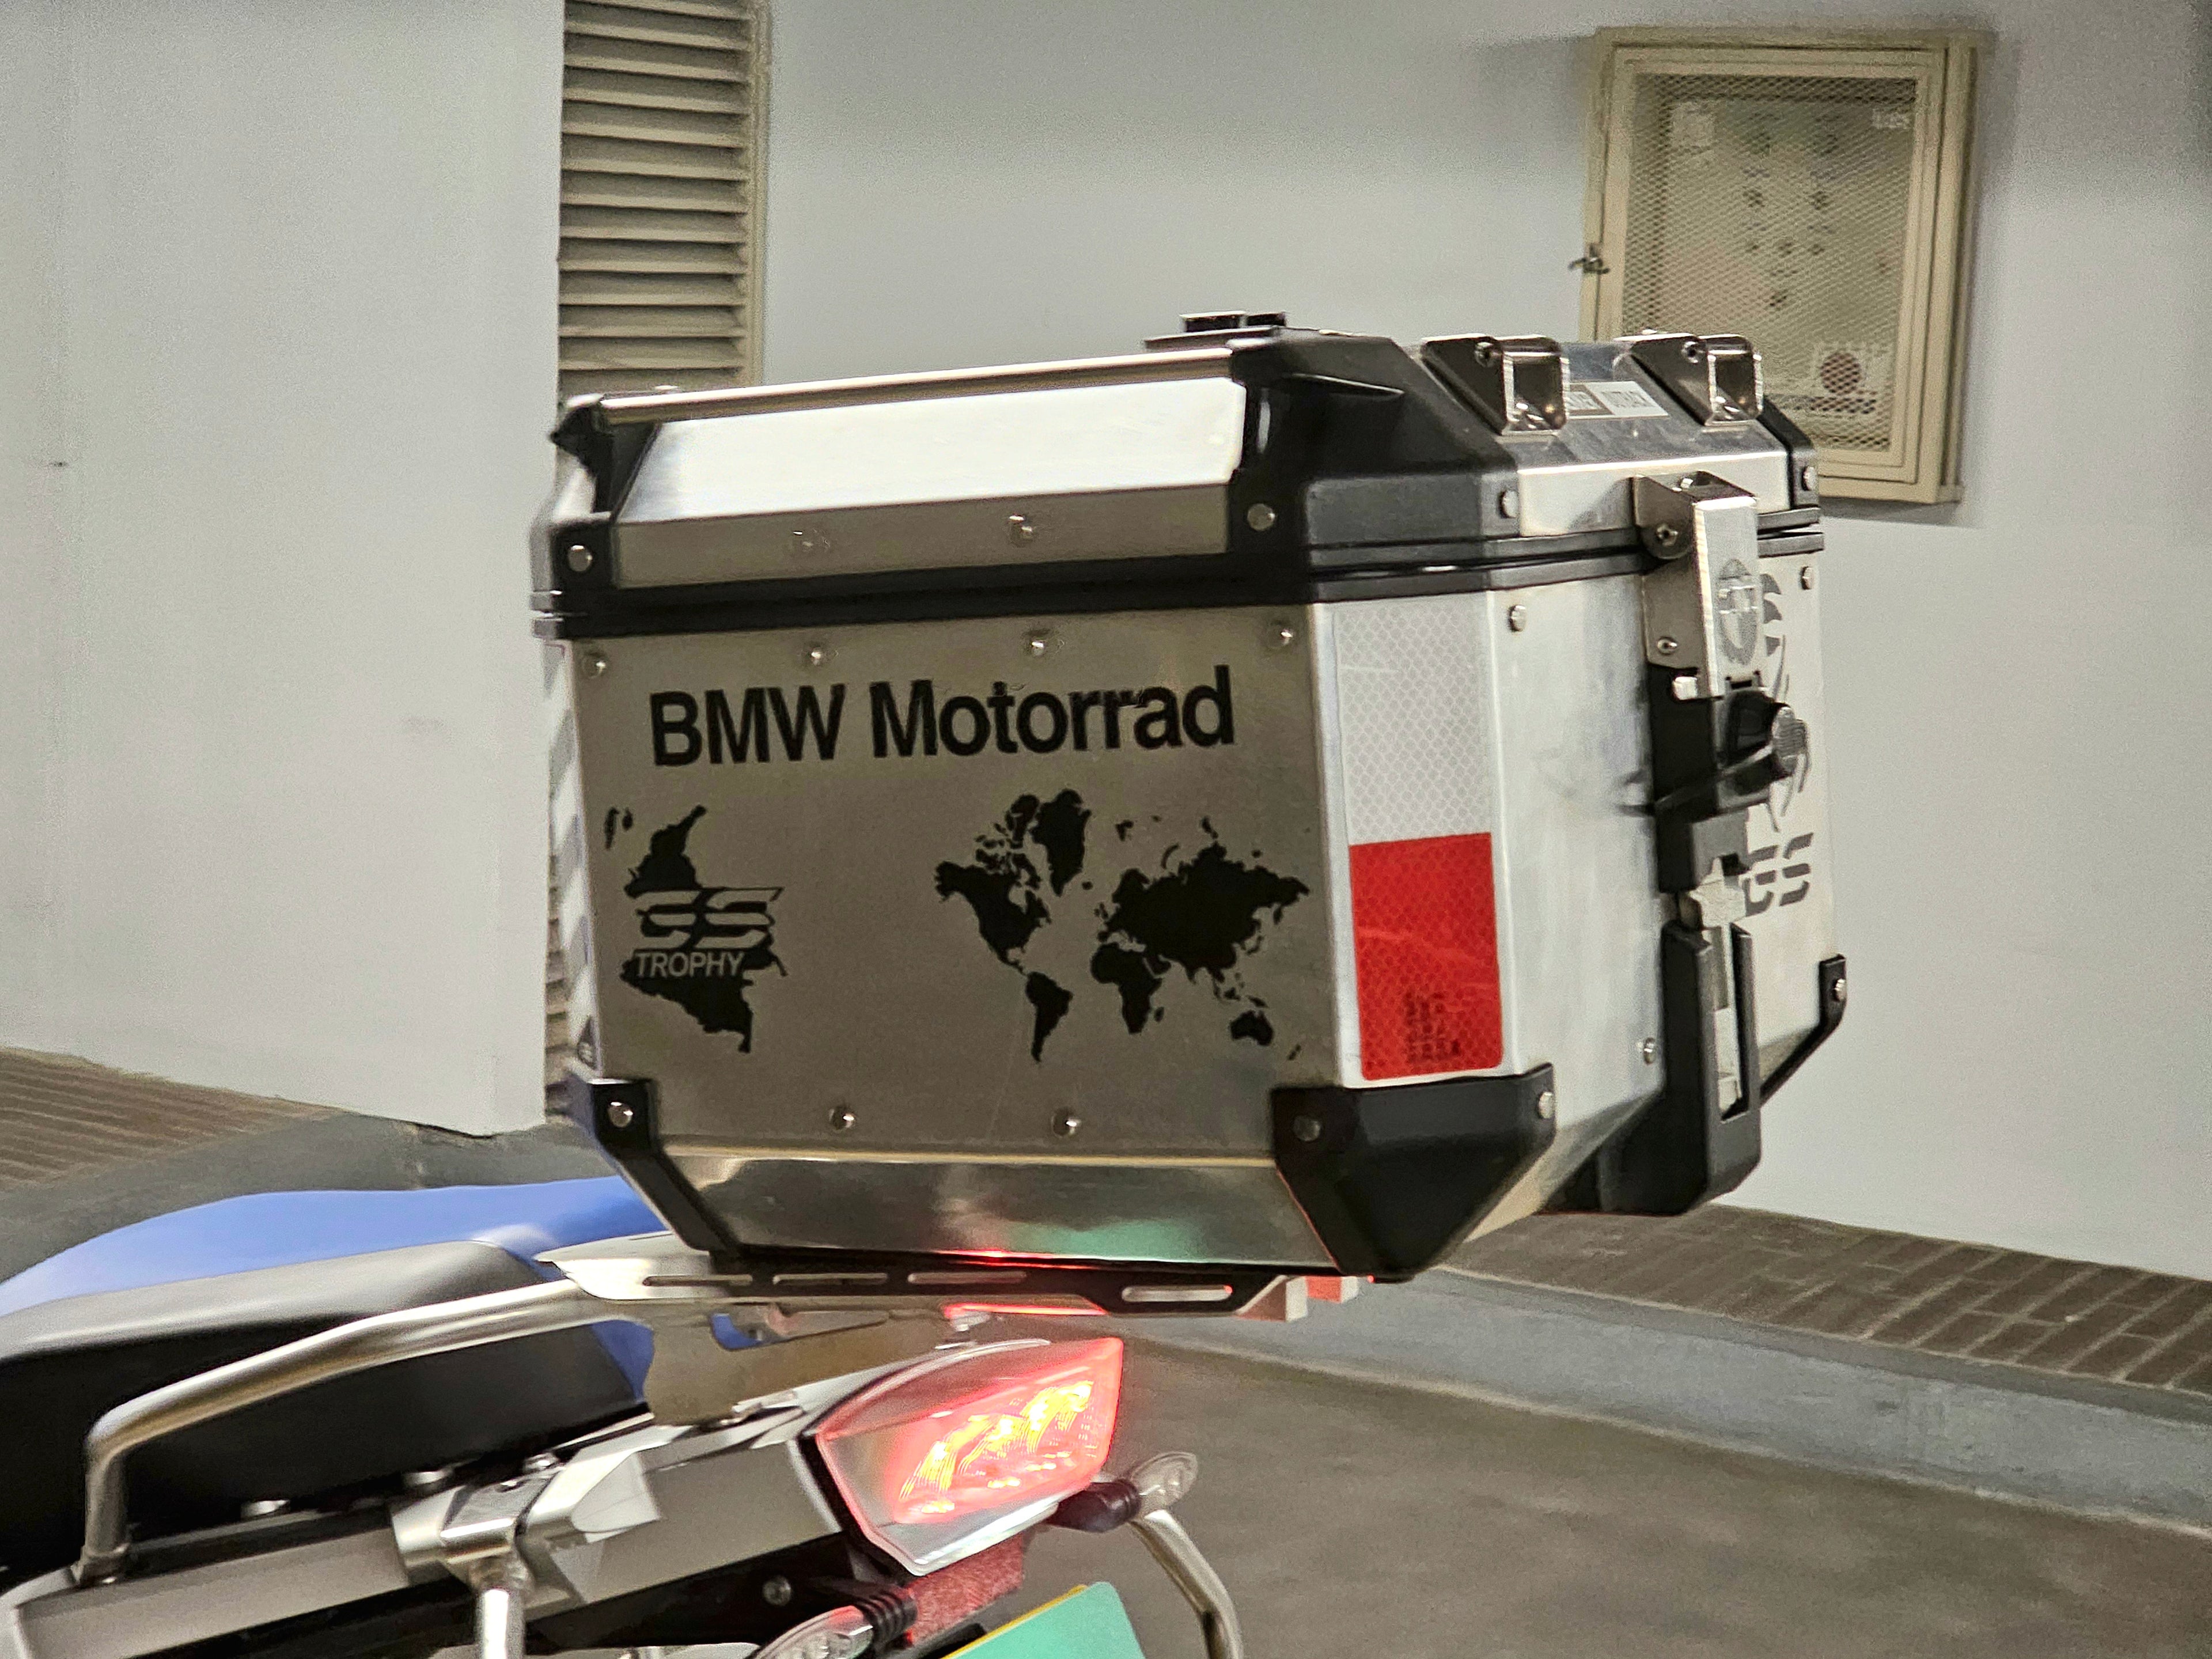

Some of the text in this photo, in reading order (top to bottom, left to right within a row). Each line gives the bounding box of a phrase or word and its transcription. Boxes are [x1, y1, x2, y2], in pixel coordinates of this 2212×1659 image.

[649, 664, 1236, 767] BMW Motorrad
[635, 951, 745, 978] TROPHY
